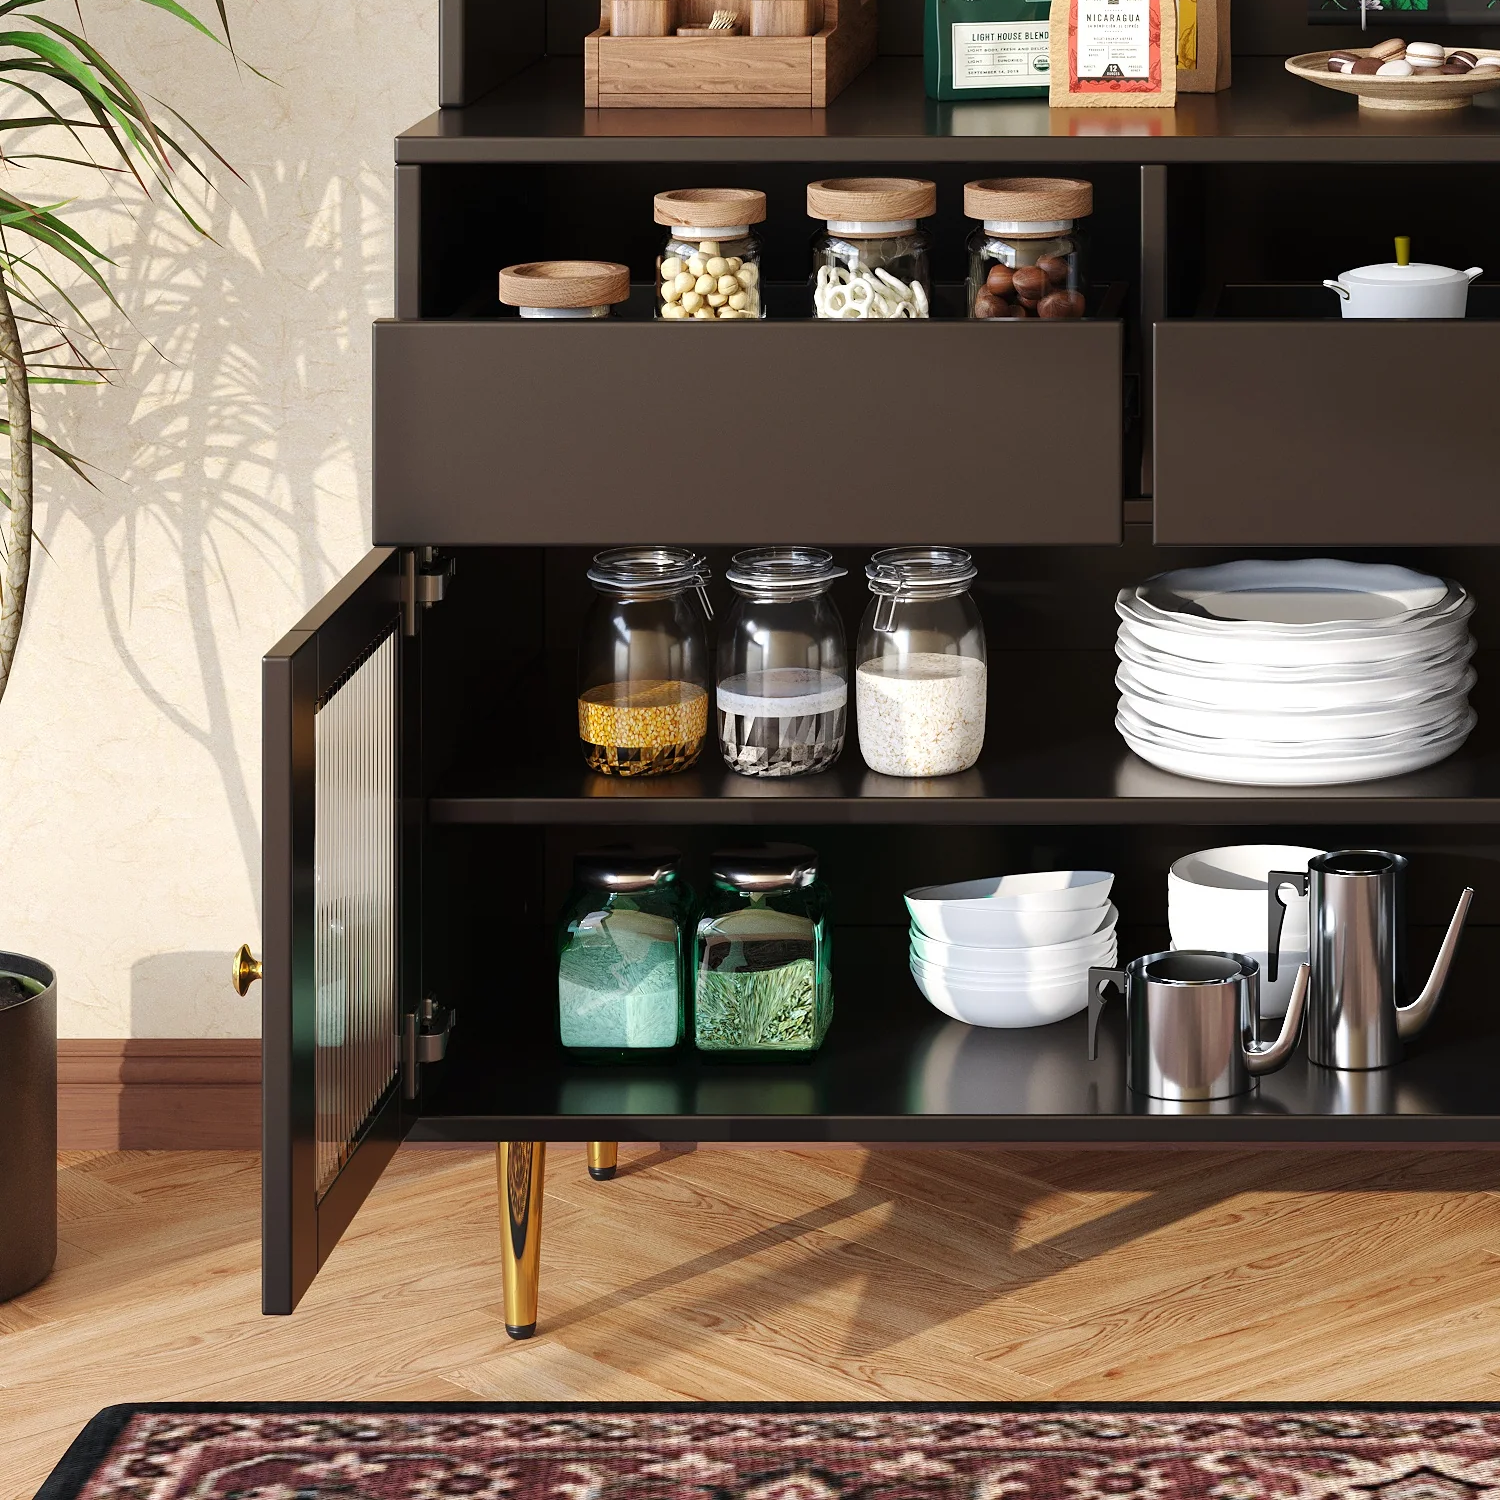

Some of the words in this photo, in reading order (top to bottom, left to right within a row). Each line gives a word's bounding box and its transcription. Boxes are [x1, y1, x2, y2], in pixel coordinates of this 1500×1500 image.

[1087, 14, 1140, 22] NICARAGUA
[972, 33, 994, 41] LIGHT
[998, 32, 1021, 40] HOUSE
